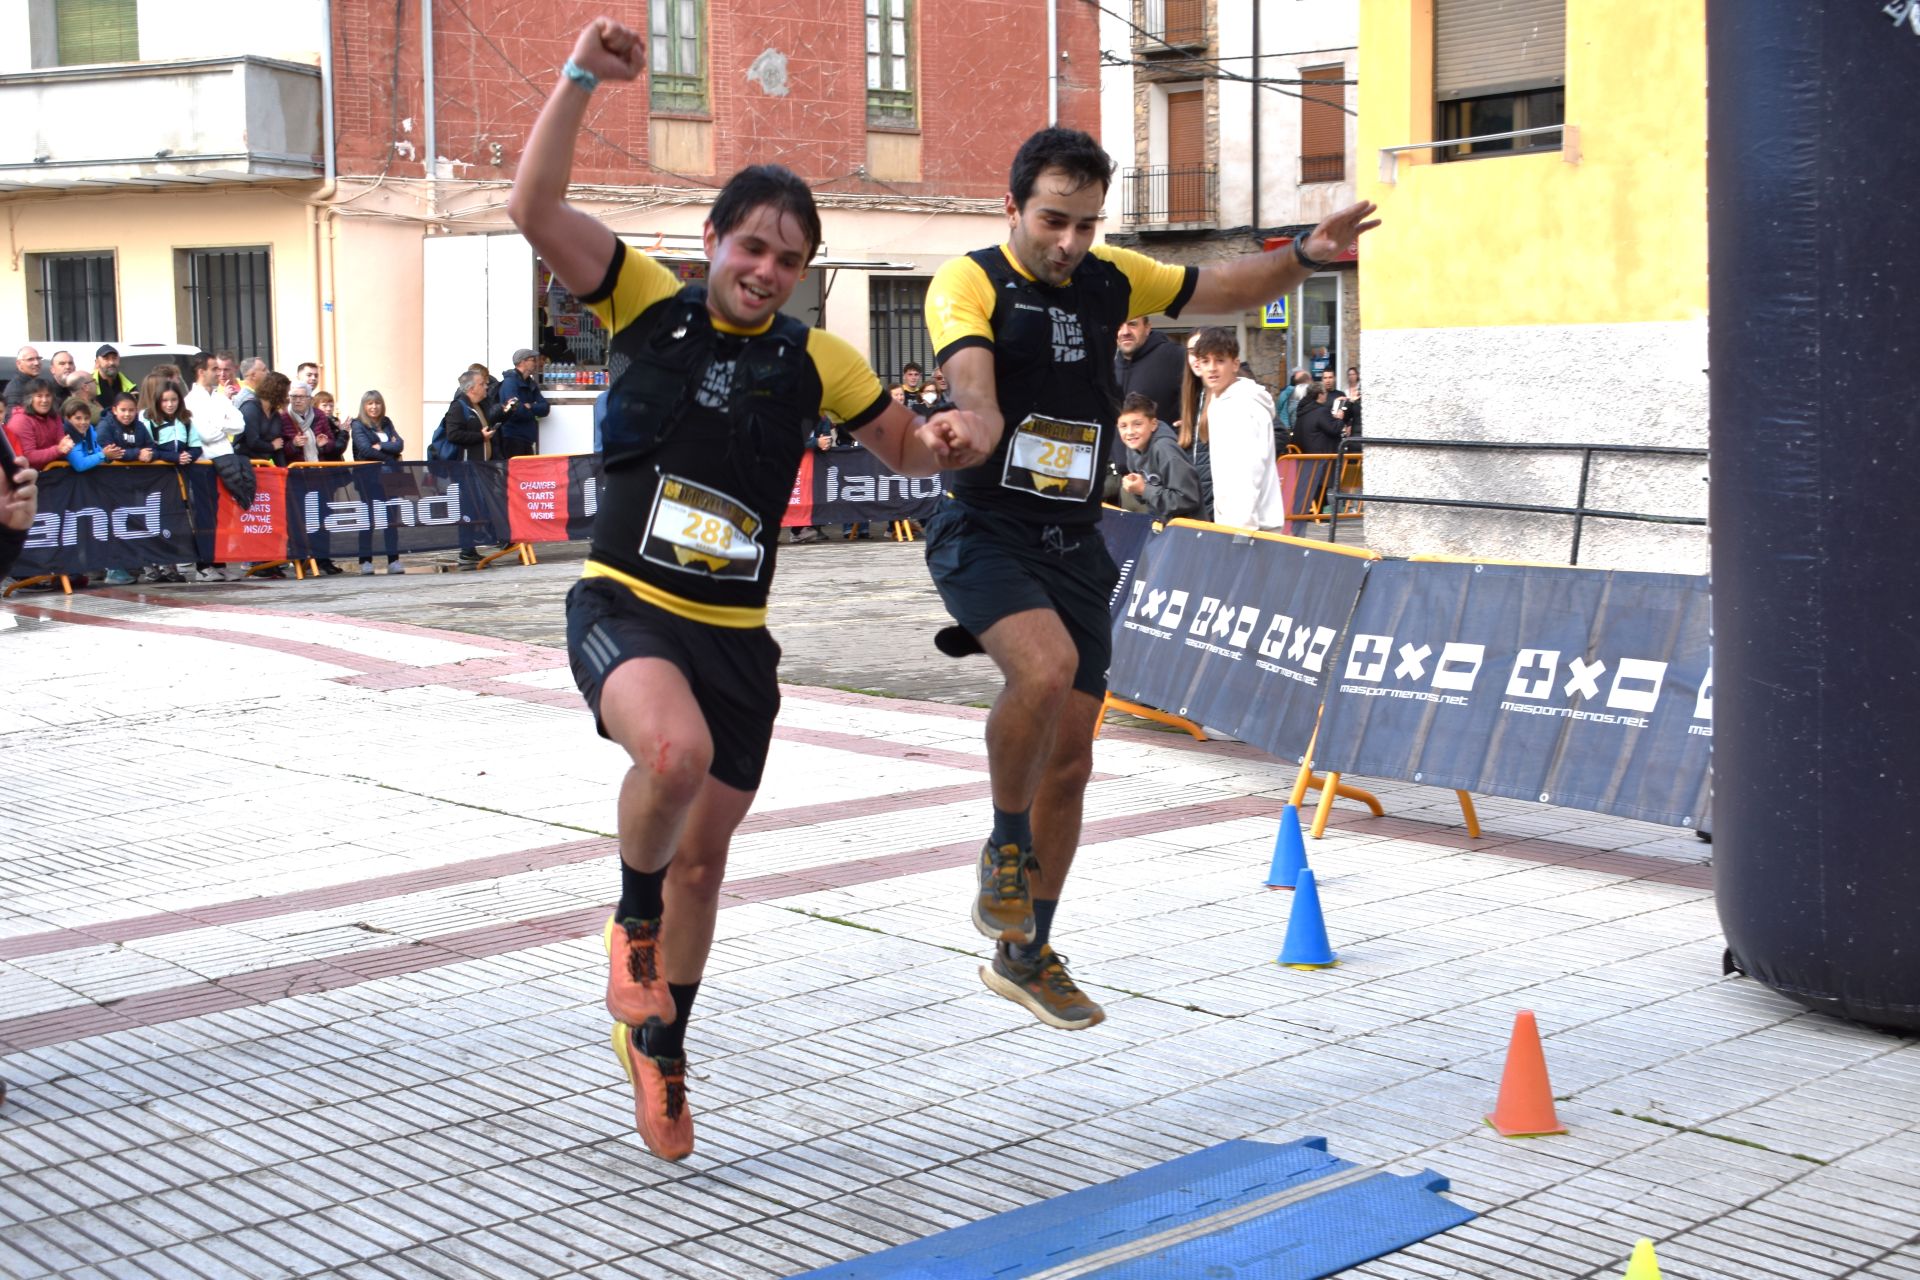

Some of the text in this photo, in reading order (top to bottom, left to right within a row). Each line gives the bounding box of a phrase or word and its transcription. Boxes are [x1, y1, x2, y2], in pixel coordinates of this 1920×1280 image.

[520, 481, 556, 490] CHANGES
[526, 492, 555, 500] STARTS
[249, 504, 271, 513] ARTS
[304, 483, 461, 534] land
[527, 502, 555, 510] ON THE
[23, 492, 162, 549] and
[241, 513, 271, 524] ON THE
[243, 524, 273, 534] INSIDE
[682, 511, 733, 550] 288
[1339, 684, 1469, 706] maspormenos.net
[1500, 701, 1649, 728] maspormenos.net
